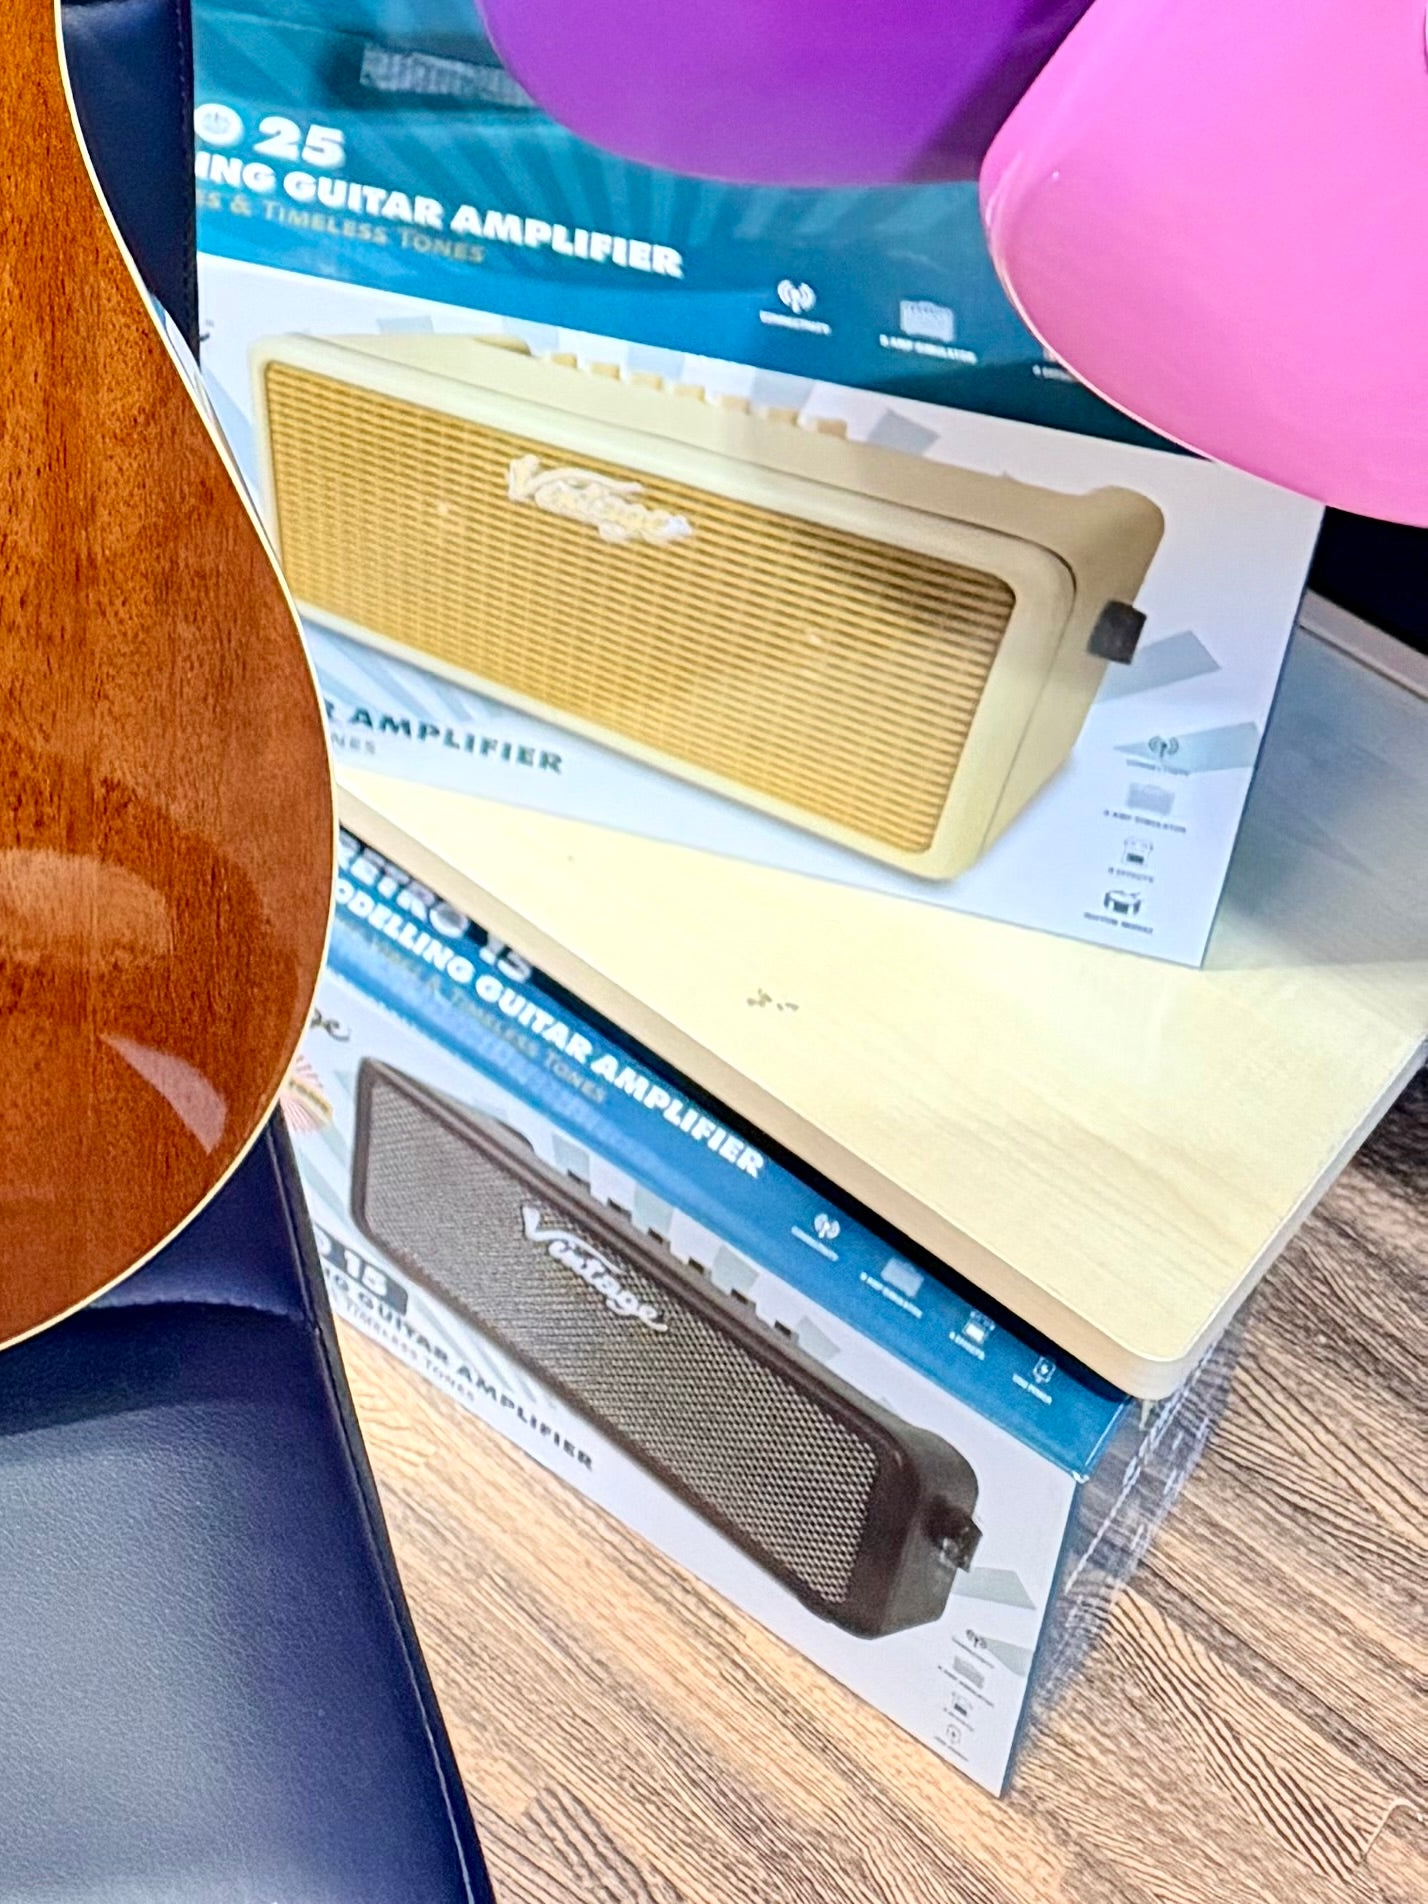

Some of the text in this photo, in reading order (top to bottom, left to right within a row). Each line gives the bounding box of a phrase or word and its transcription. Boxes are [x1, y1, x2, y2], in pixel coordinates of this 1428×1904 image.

[254, 116, 346, 170] 25
[283, 169, 445, 232] GUITAR
[449, 204, 686, 280] AMPLIFIER
[348, 706, 564, 775] AMPLIFIER
[336, 878, 767, 1179] ODELLING GUITAR AMPLIFIER
[521, 1204, 669, 1333] Vintage
[455, 1364, 594, 1471] AMPLIFIER
